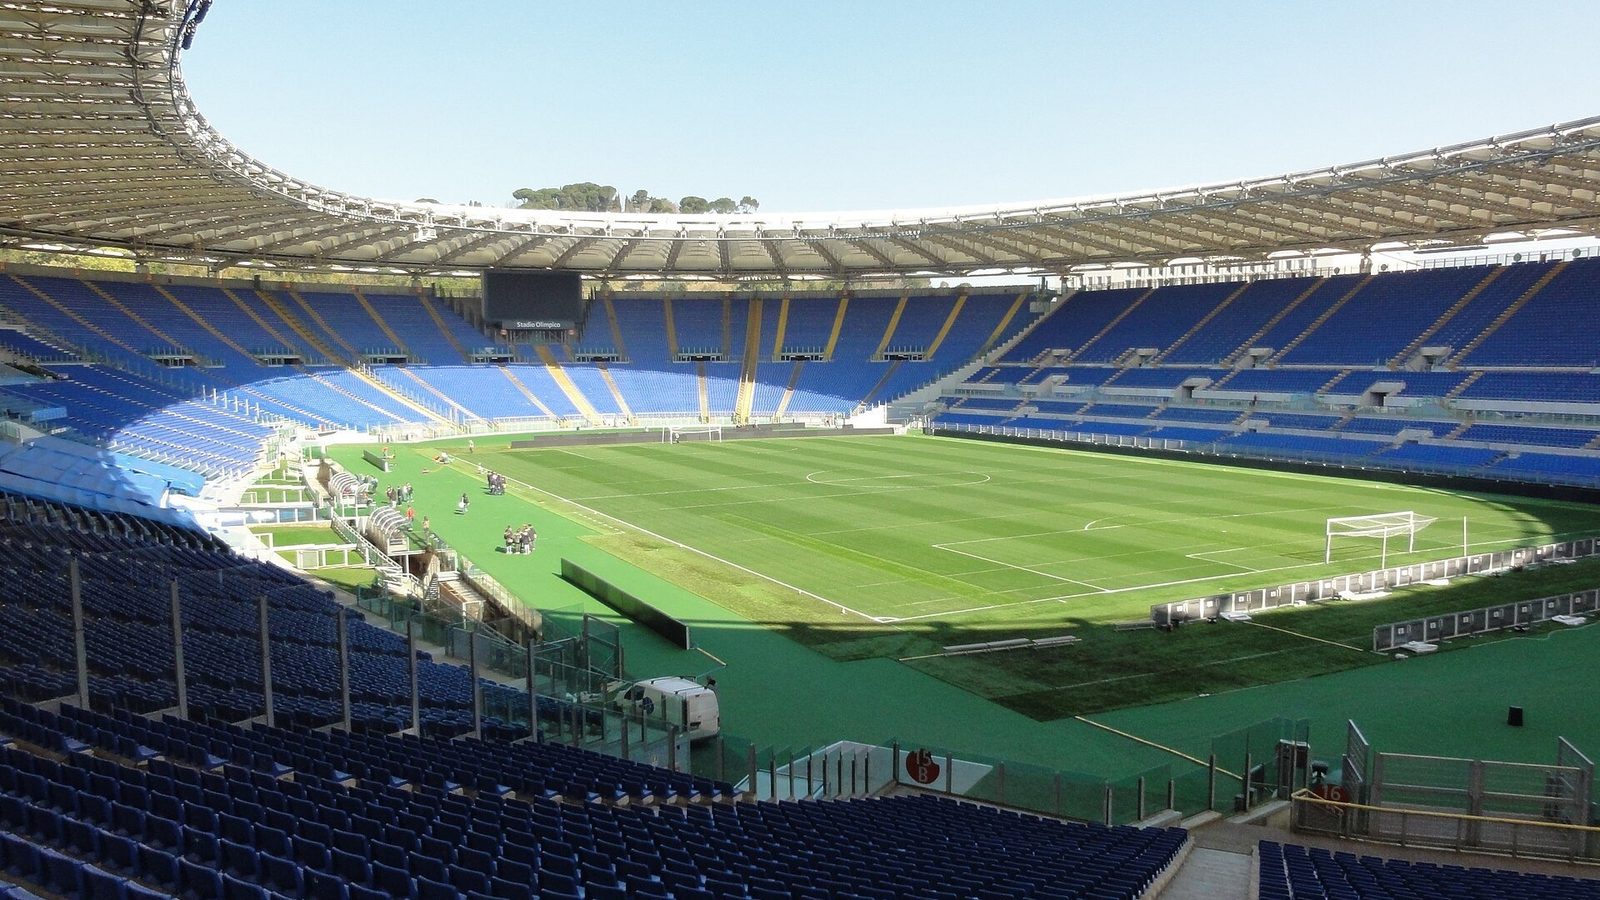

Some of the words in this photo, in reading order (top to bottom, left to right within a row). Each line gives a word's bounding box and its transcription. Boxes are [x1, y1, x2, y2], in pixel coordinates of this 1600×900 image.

[535, 321, 561, 329] Olimpico
[918, 766, 928, 782] B
[1321, 784, 1341, 801] 16
